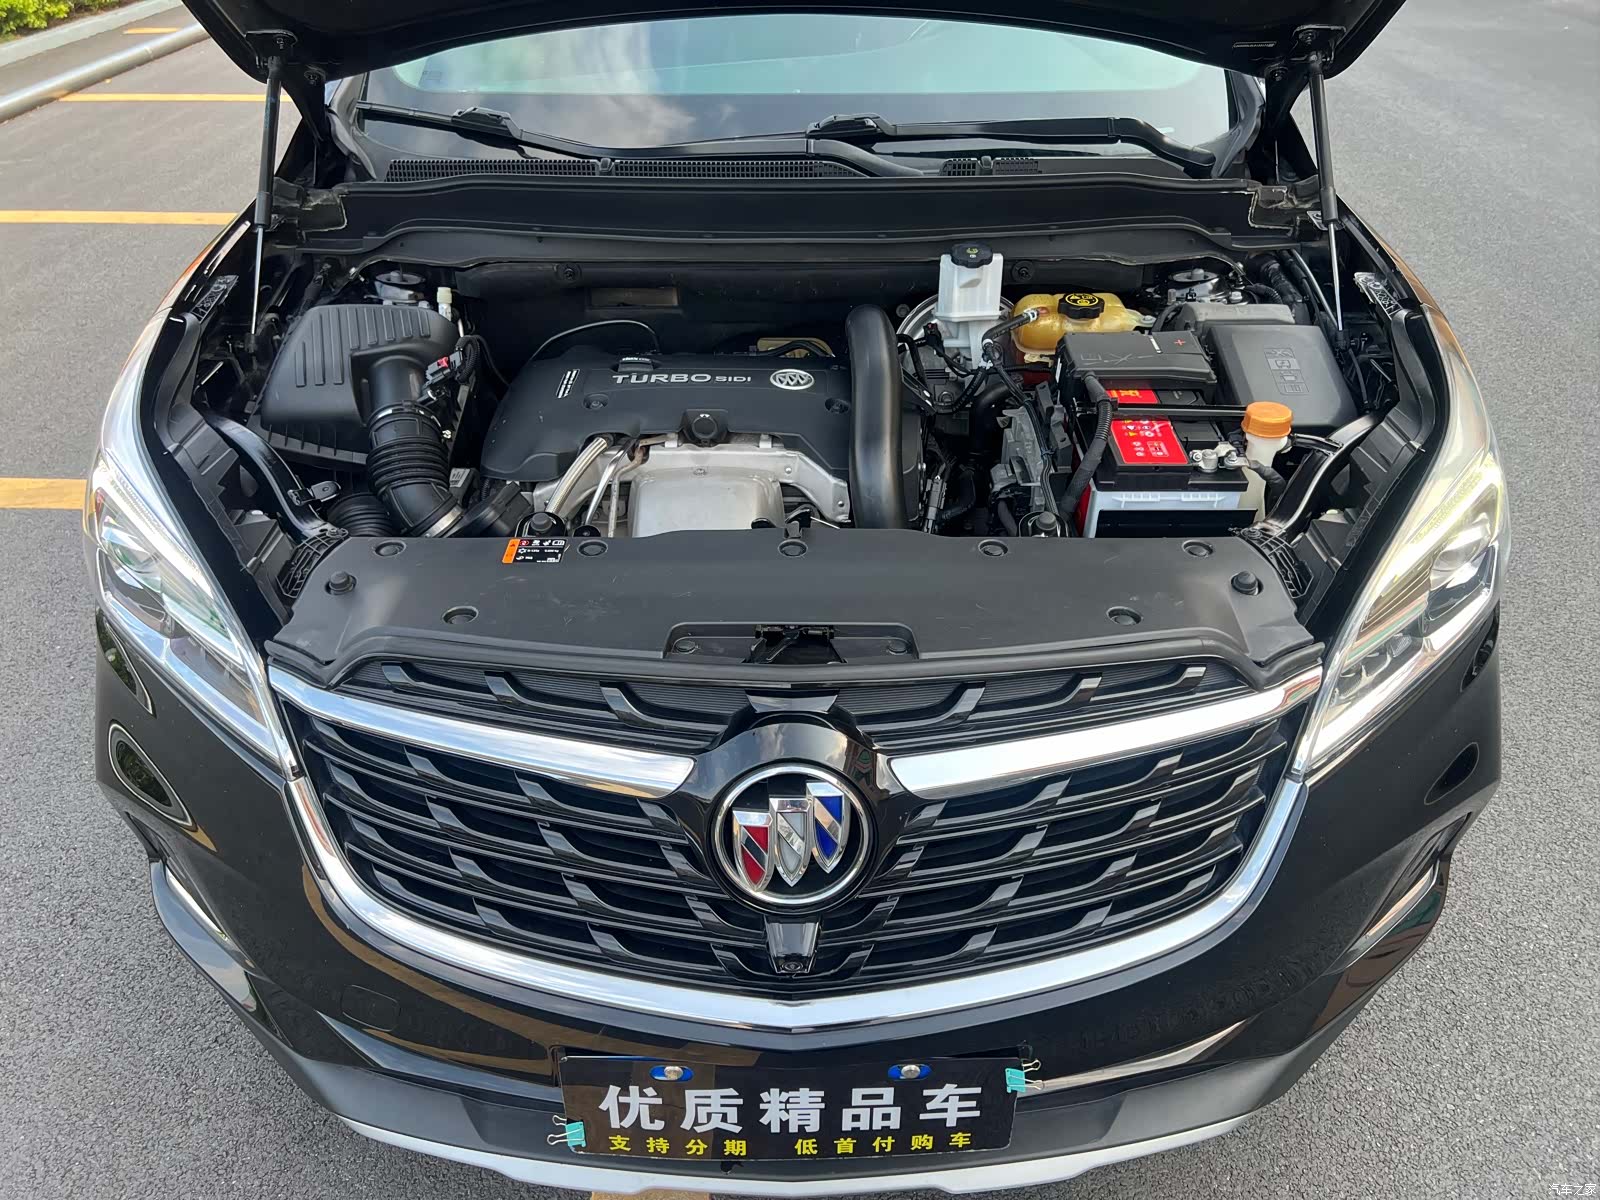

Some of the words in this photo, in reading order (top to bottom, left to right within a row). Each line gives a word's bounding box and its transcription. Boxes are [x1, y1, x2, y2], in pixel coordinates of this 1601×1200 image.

[612, 373, 712, 384] TURBO
[598, 1084, 982, 1133] 优质精品车
[608, 1134, 747, 1157] 支持分期
[794, 1132, 972, 1156] 低首付购车
